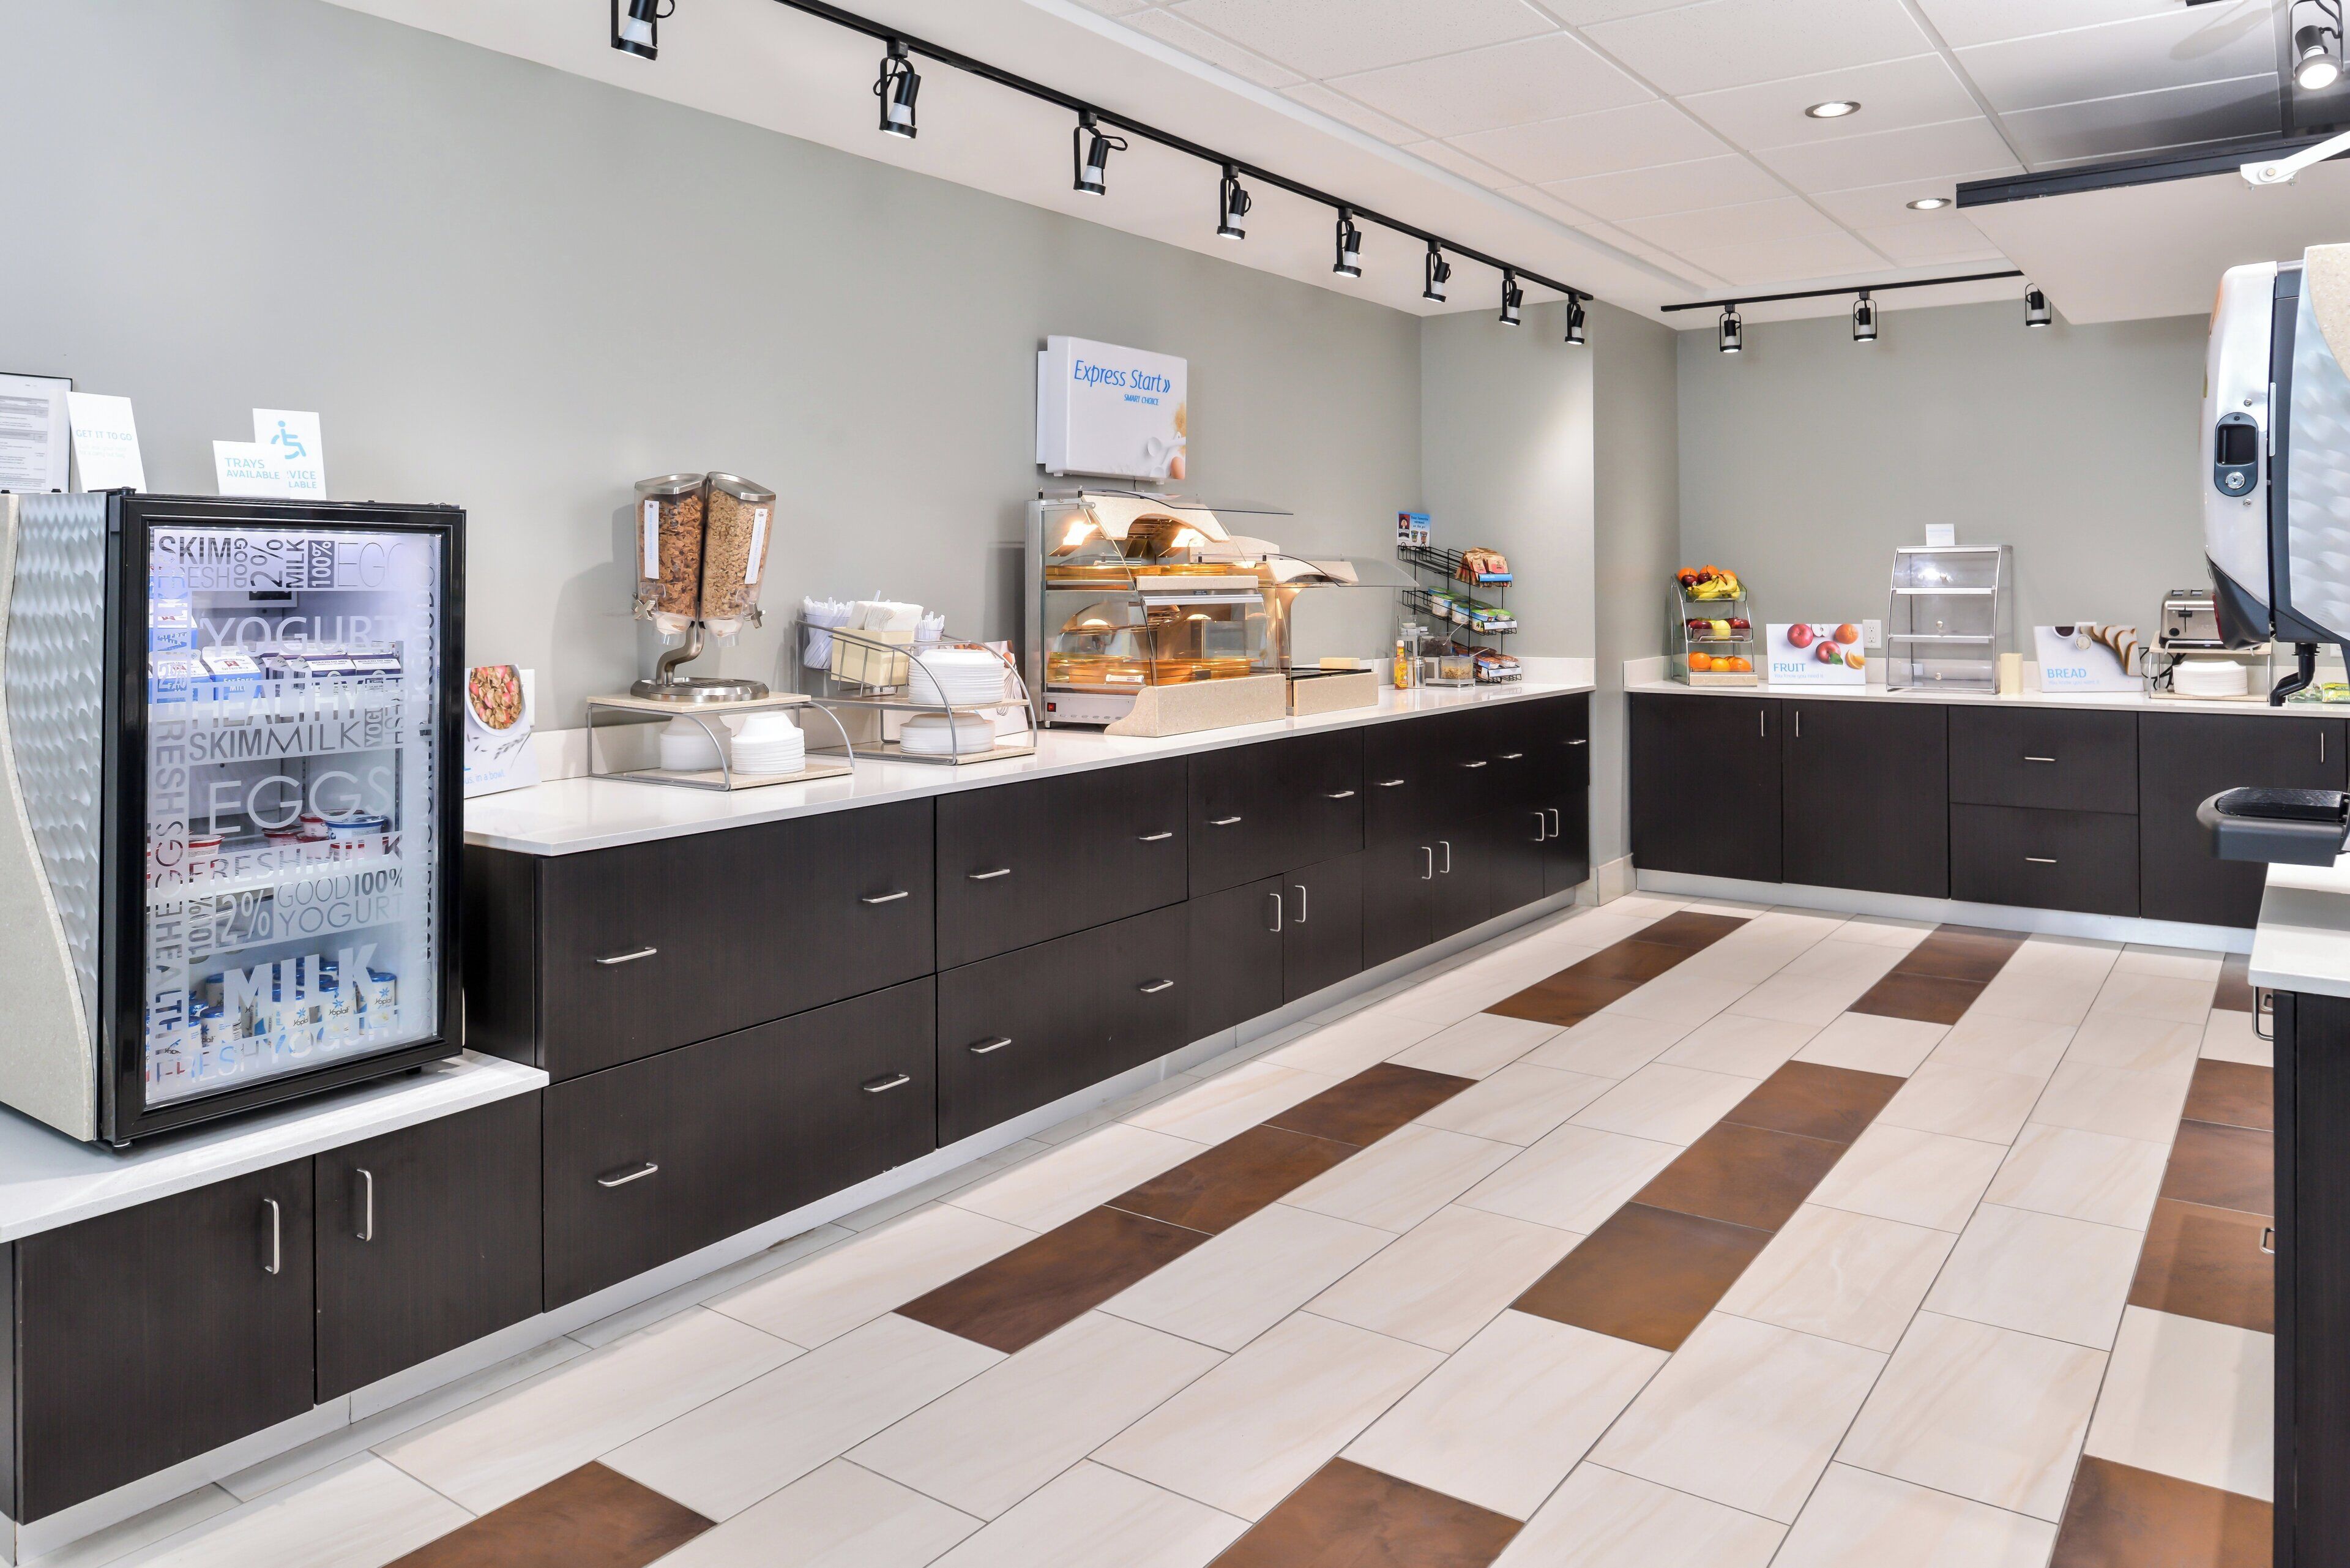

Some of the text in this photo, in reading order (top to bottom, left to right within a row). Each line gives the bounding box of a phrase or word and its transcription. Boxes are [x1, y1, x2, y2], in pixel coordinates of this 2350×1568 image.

[1074, 359, 1162, 392] Express Start
[1124, 394, 1159, 406] SMART CHOICE
[76, 429, 93, 439] GET
[96, 430, 105, 439] IT
[107, 431, 118, 440] TO
[225, 457, 265, 469] TRAYS
[226, 469, 280, 480] AVAILABLE
[287, 471, 316, 480] VICE
[159, 536, 231, 565] SKIM
[234, 537, 248, 589] GOOD
[250, 539, 284, 588] 2%
[286, 539, 305, 589] MILK
[311, 540, 332, 588] 100%
[200, 616, 397, 657] YOGURT
[1774, 663, 1806, 672] FRUIT
[2047, 668, 2087, 678] BREAD
[192, 679, 365, 729] HEALTHY
[189, 721, 362, 761] SKIM MILK
[209, 766, 392, 835] EGGS
[189, 835, 404, 889] FRESH MILK
[277, 865, 403, 908] GOOD 100%
[221, 889, 270, 943] 2%
[278, 893, 404, 936] YOGURT
[223, 943, 377, 1021] MILK
[329, 1006, 350, 1017] Yoplait
[202, 1036, 214, 1044] plait
